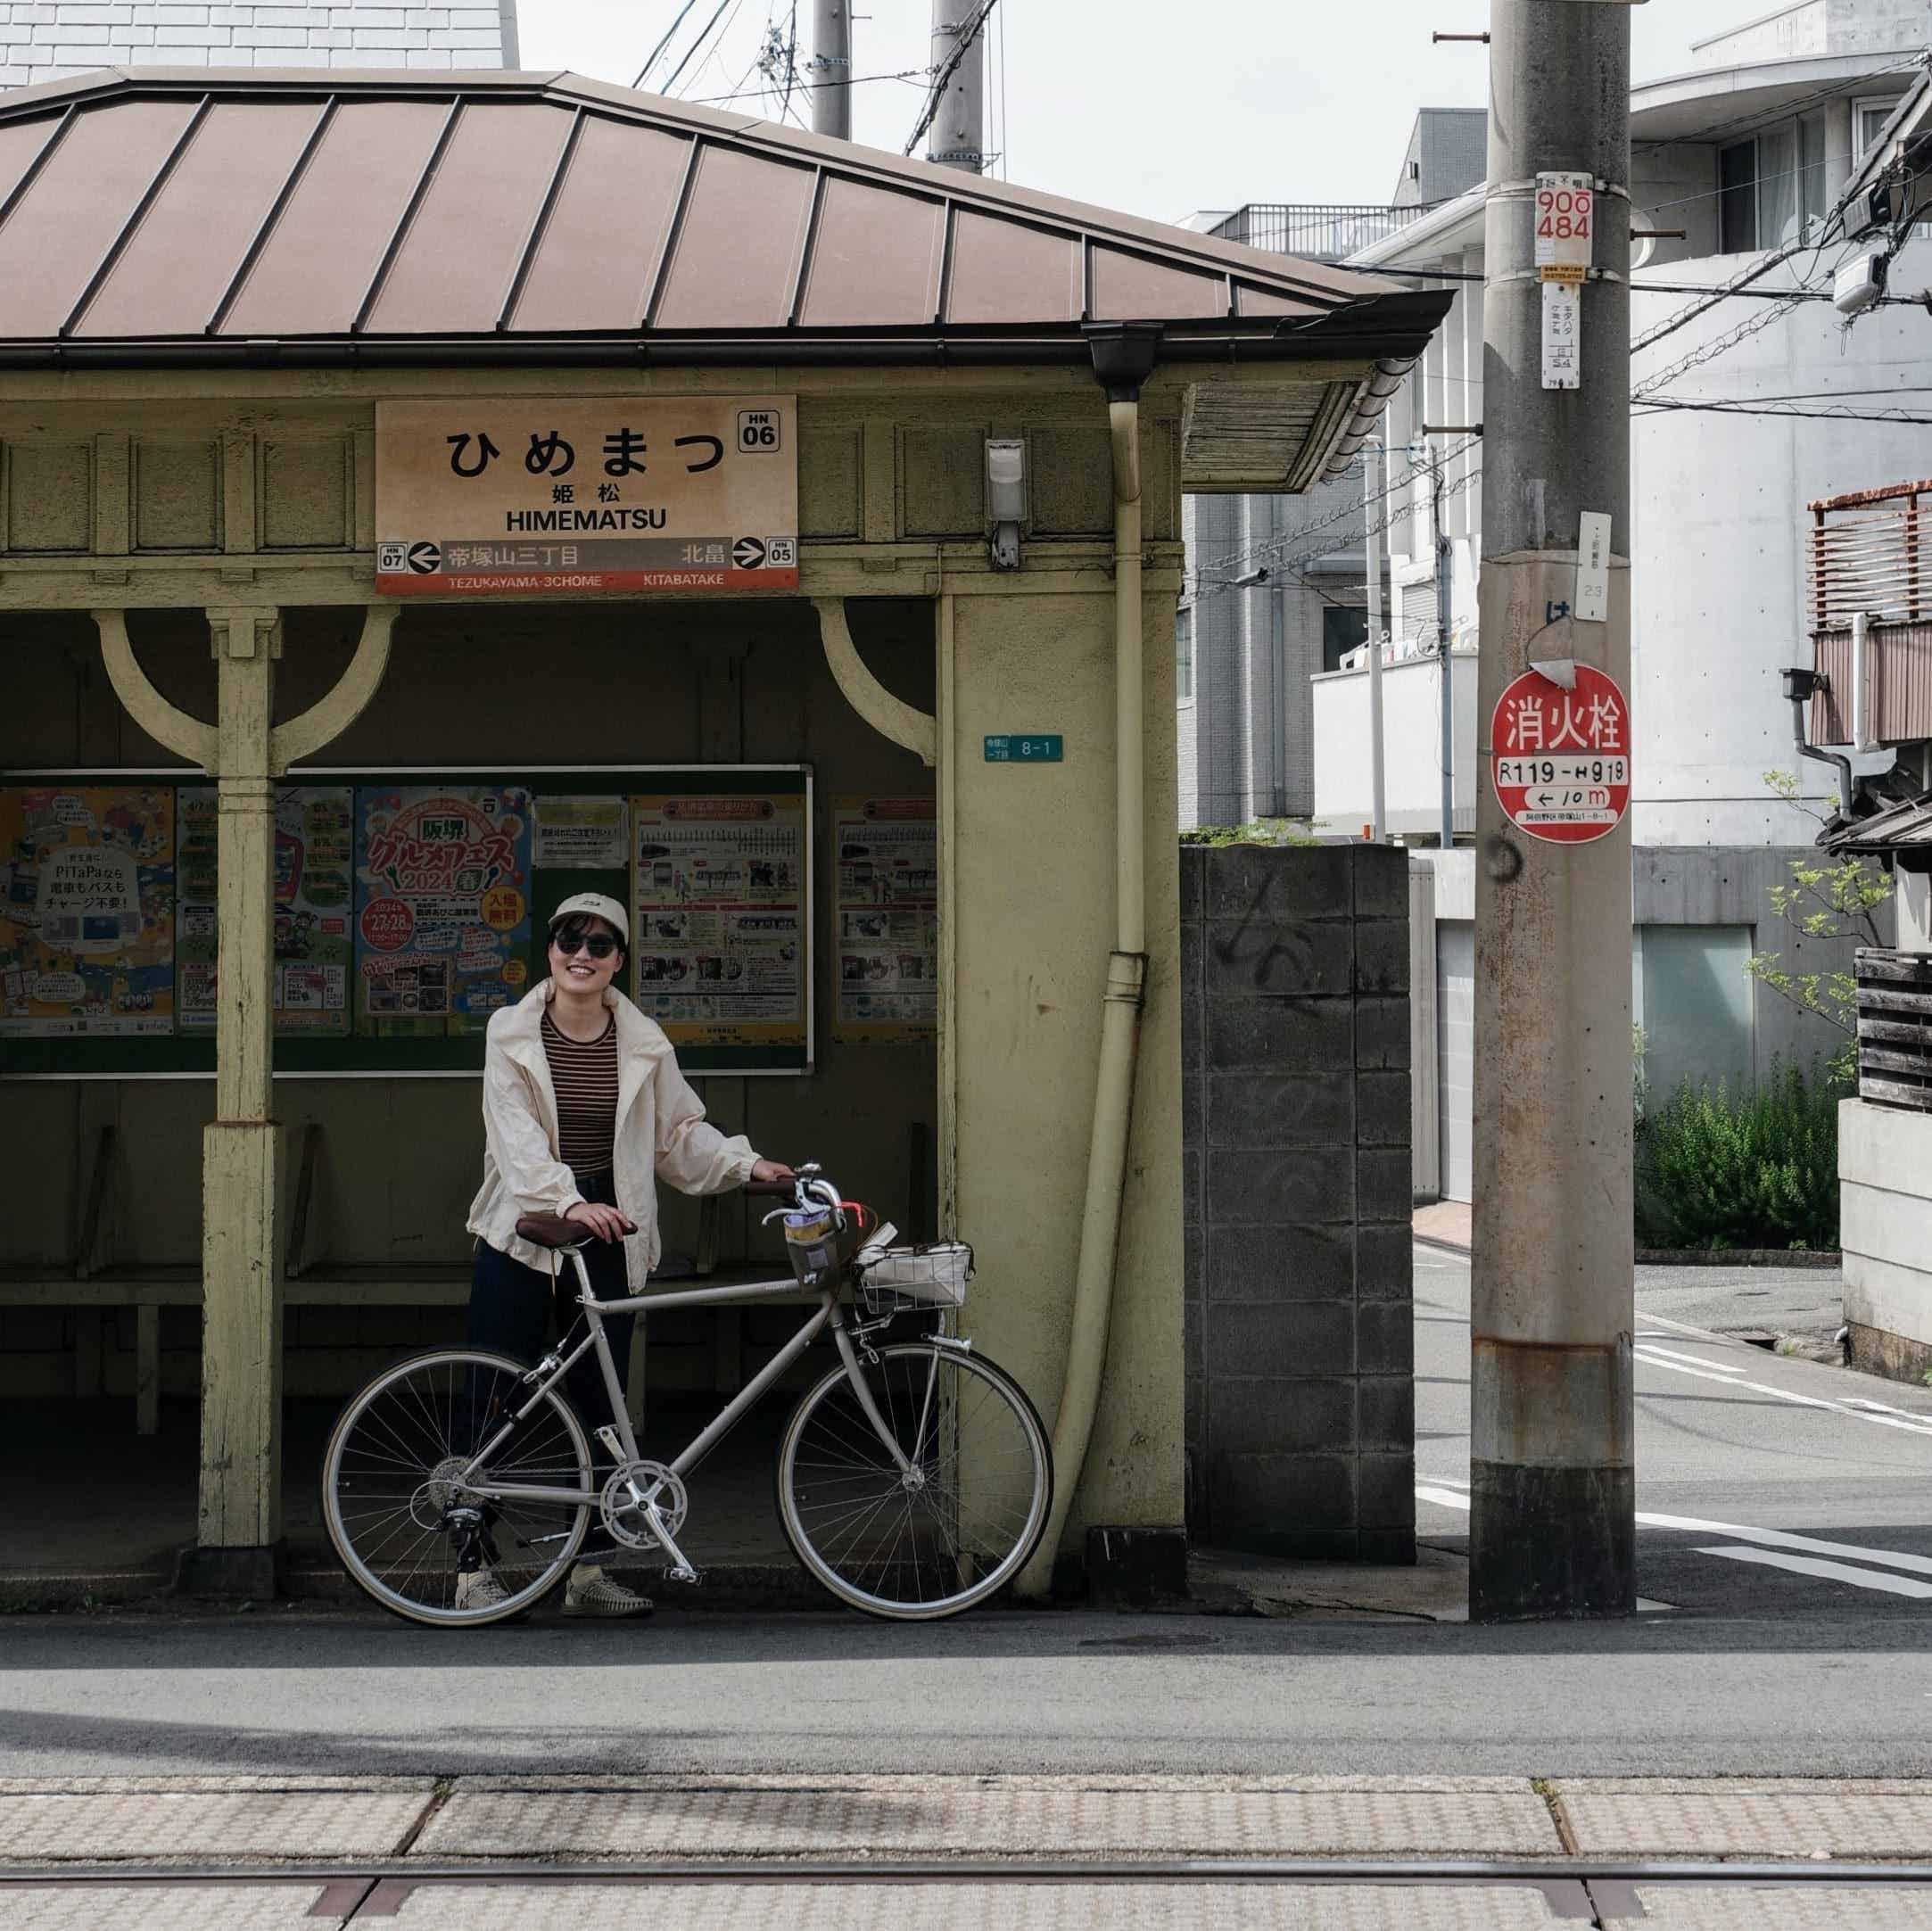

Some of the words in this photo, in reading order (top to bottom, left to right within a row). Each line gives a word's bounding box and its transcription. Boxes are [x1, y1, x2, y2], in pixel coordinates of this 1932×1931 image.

[1539, 192, 1590, 213] 900
[1538, 217, 1589, 240] 484
[749, 415, 768, 423] HN
[742, 425, 774, 446] 06
[447, 428, 723, 477] ひめまつ
[552, 483, 620, 504] 姫松
[507, 508, 666, 531] HIMEMATSU
[383, 554, 402, 566] 07
[448, 546, 578, 566] 帝塚山三丁目
[772, 549, 791, 562] 05
[644, 574, 724, 586] KITABATAKE
[1506, 695, 1621, 750] 消火栓
[1021, 741, 1050, 755] 8-1
[368, 835, 516, 874] グルメフェス
[50, 882, 126, 894] 電車もバスも
[404, 871, 451, 890] 2024
